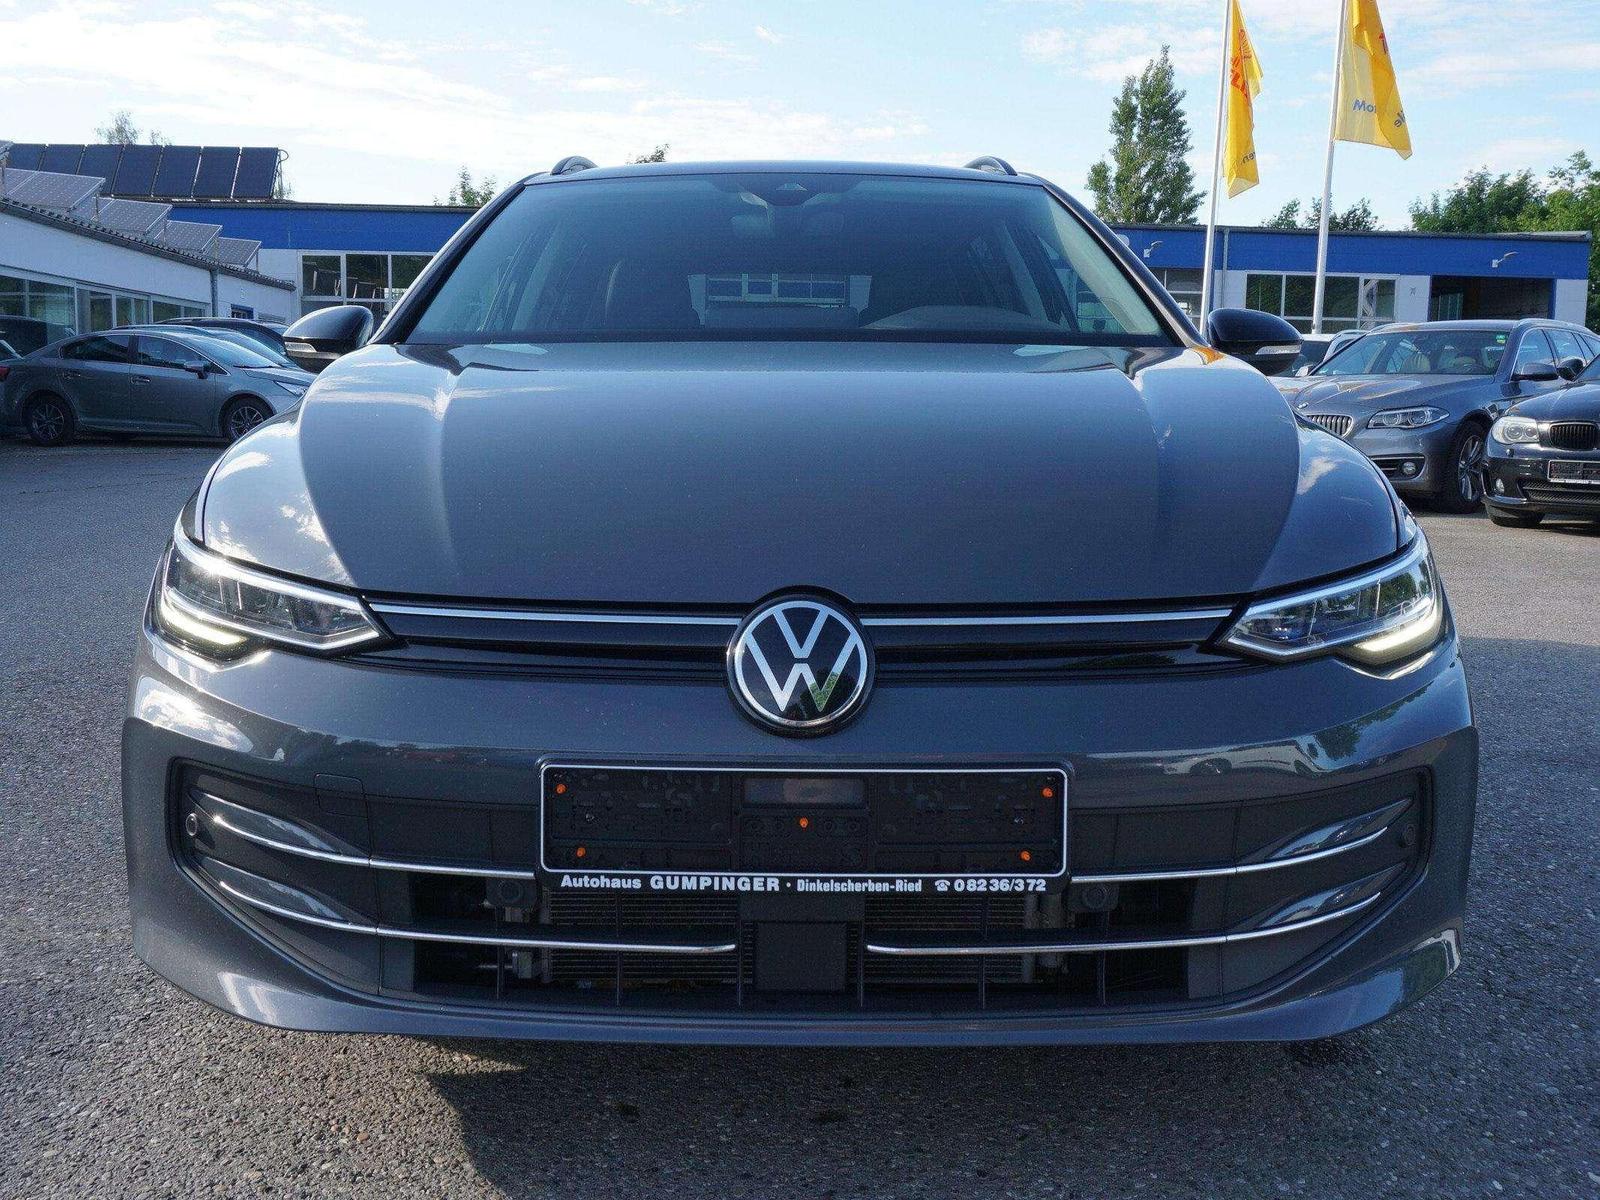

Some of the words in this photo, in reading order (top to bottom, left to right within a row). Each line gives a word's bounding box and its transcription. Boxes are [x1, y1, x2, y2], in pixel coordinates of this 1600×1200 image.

[560, 874, 642, 889] Autohaus
[650, 875, 780, 892] GUMPINGER
[796, 878, 923, 893] Dinkelscherben-Ried
